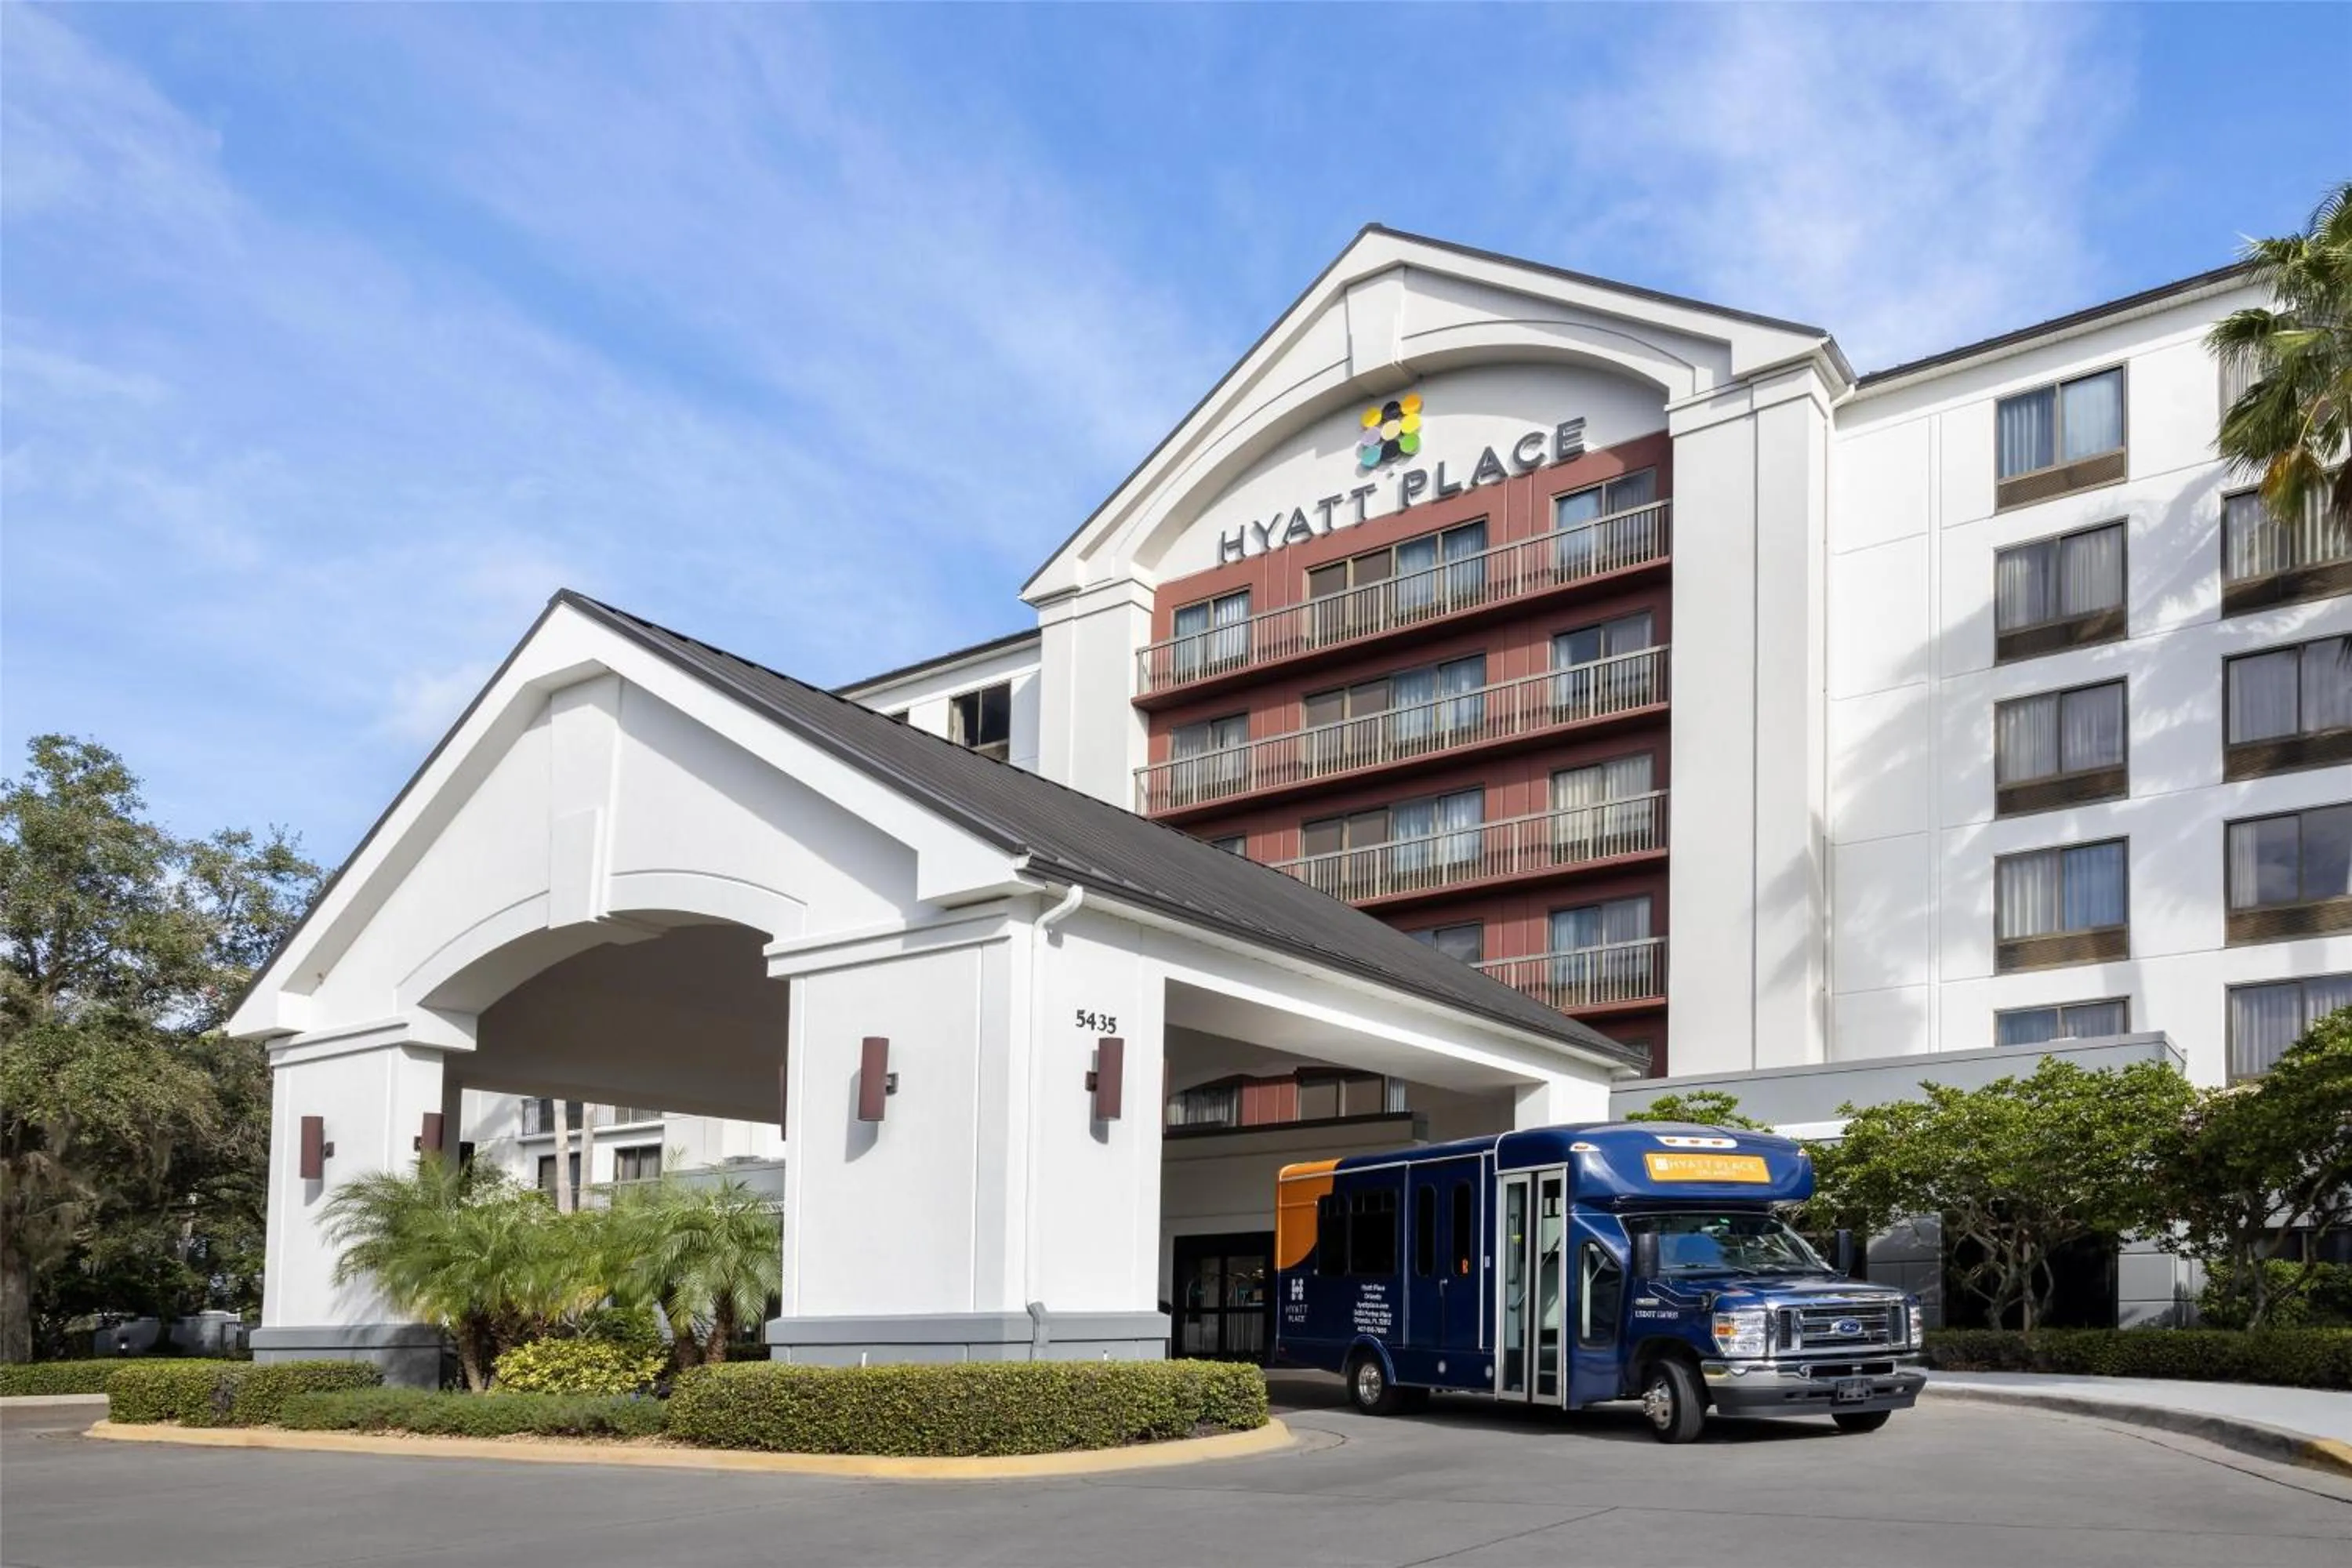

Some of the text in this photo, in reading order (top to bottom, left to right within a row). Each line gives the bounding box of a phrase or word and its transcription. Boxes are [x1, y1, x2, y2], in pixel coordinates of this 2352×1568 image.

[1218, 416, 1587, 564] HYATT PLACE
[1075, 1009, 1117, 1034] 5435
[1285, 1304, 1308, 1315] HYATT
